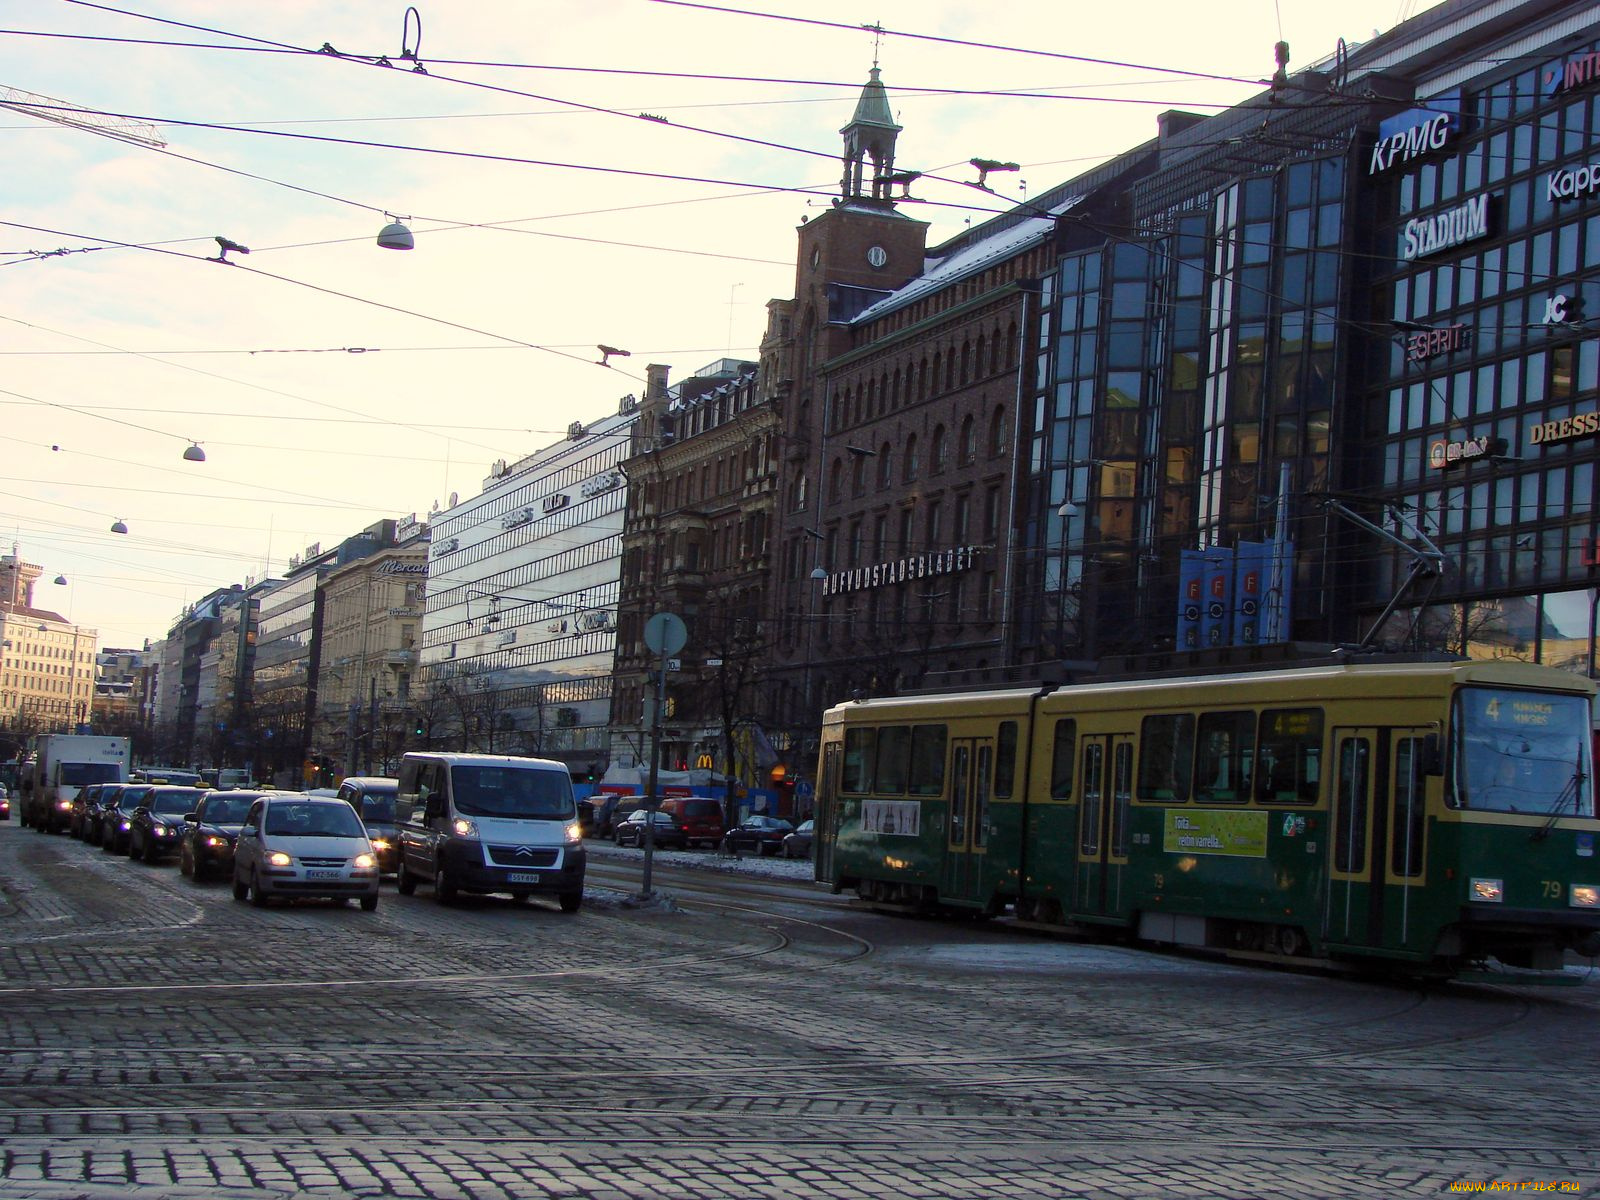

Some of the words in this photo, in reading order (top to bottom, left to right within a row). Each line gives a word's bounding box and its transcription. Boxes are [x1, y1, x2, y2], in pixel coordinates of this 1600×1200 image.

[1369, 113, 1450, 175] KPMG
[1543, 294, 1567, 324] JC
[1407, 323, 1463, 361] ESPRIT
[1530, 411, 1600, 445] DRESS
[1486, 698, 1499, 721] 4
[1540, 880, 1561, 898] 79
